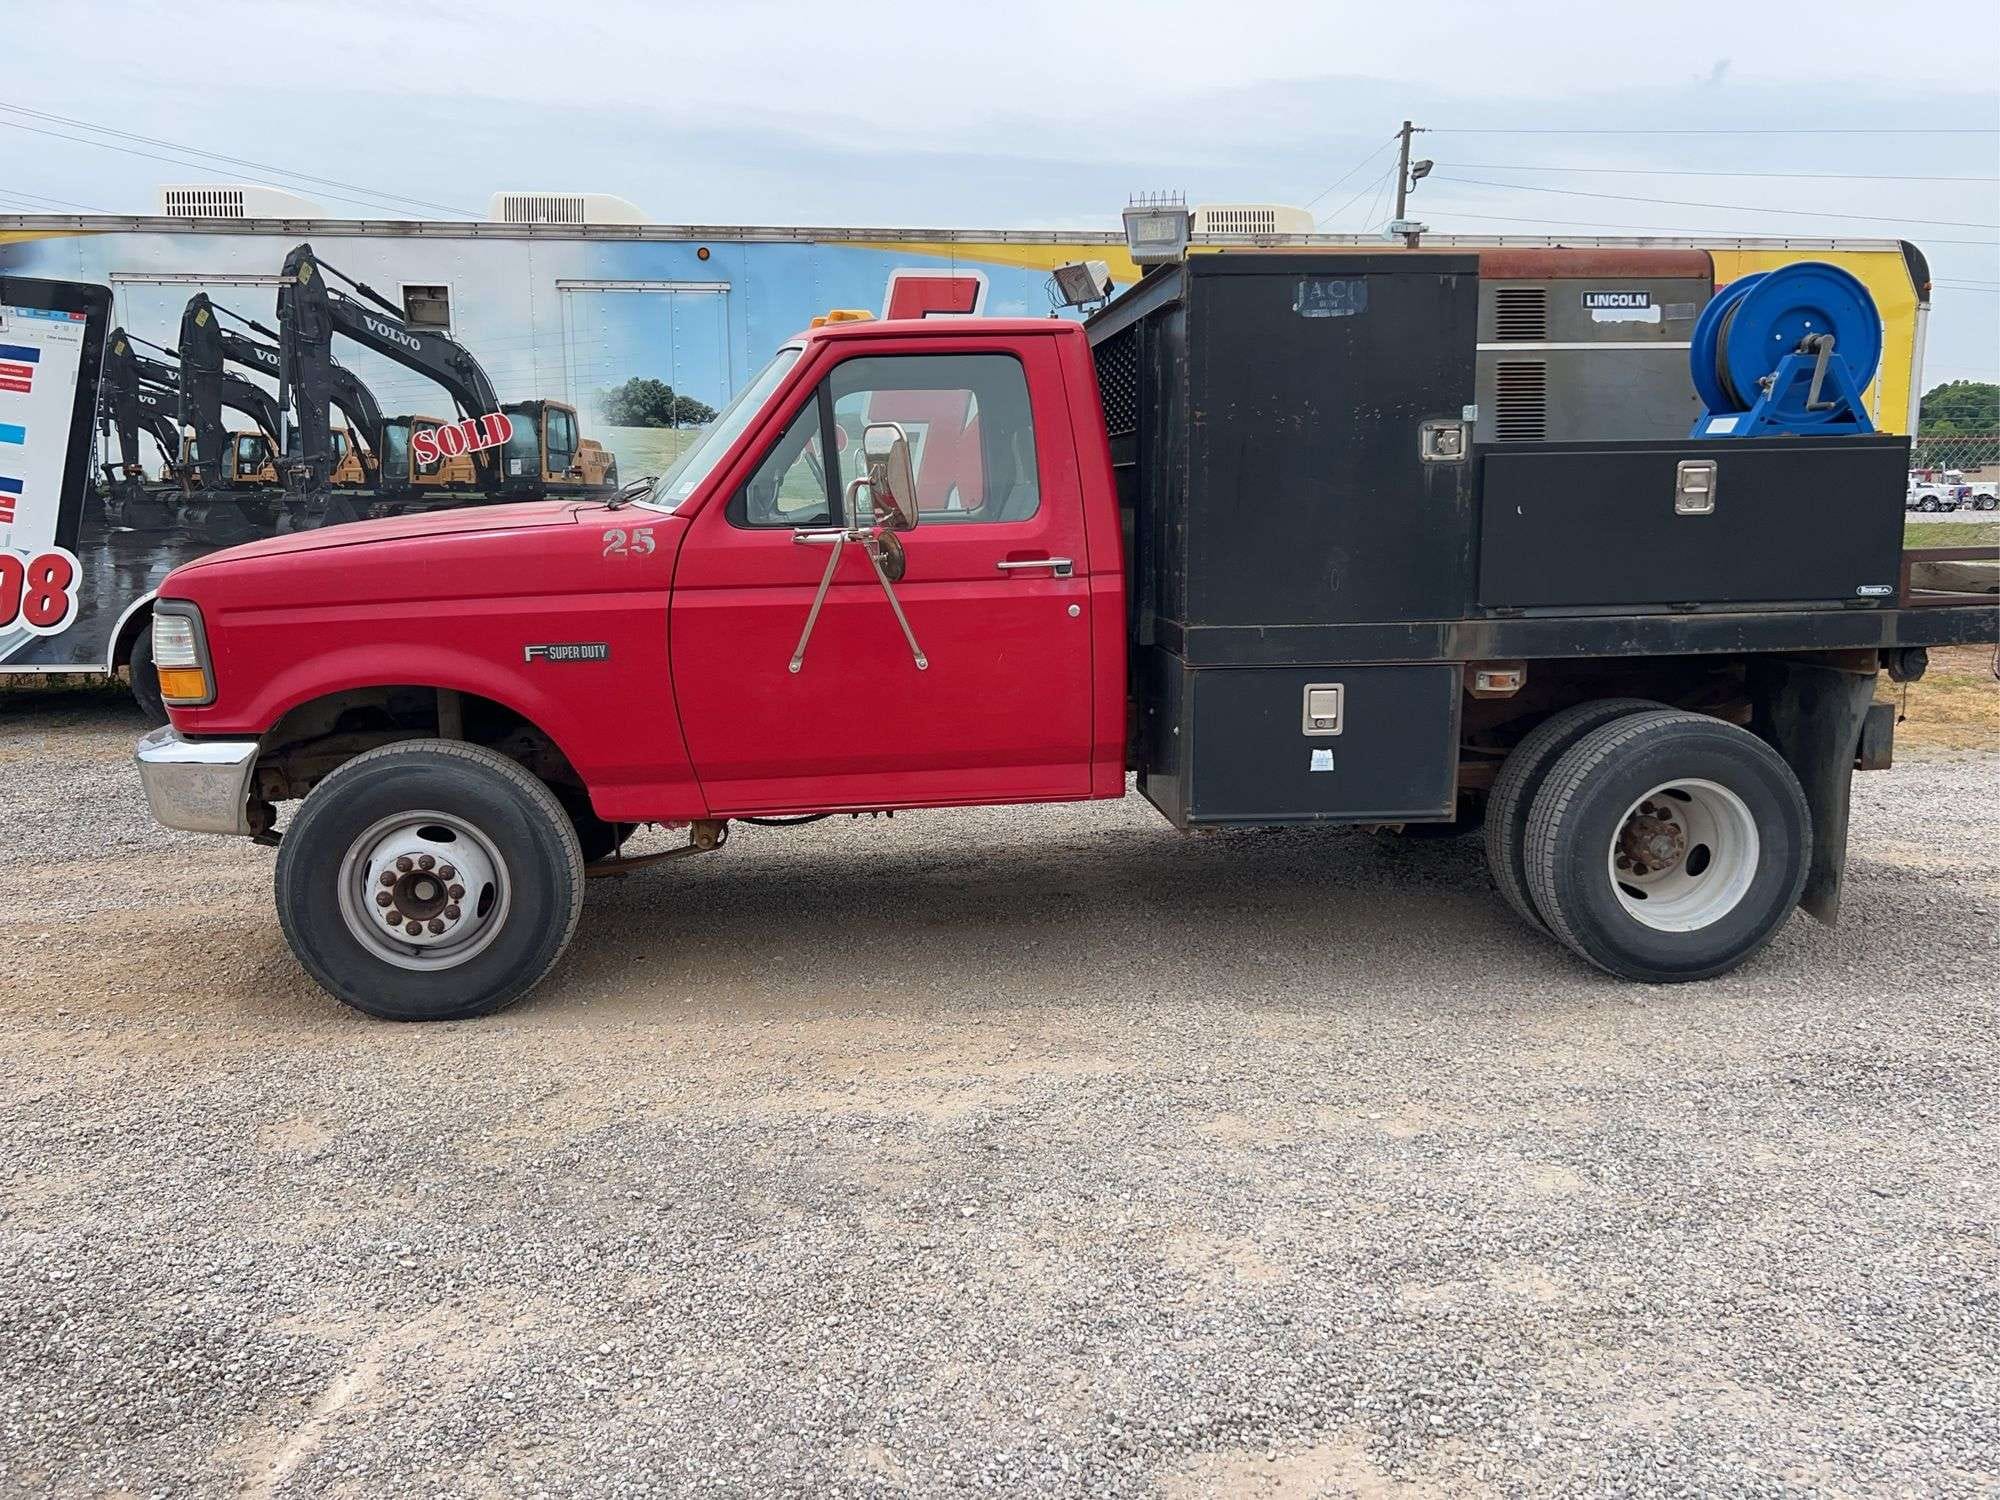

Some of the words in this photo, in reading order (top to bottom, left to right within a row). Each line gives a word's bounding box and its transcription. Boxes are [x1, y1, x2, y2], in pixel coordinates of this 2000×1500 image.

[1586, 294, 1648, 307] LINCOLN
[362, 315, 421, 351] VOLVO
[412, 413, 513, 465] SOLD
[603, 528, 656, 557] 25
[581, 645, 606, 658] DUTY
